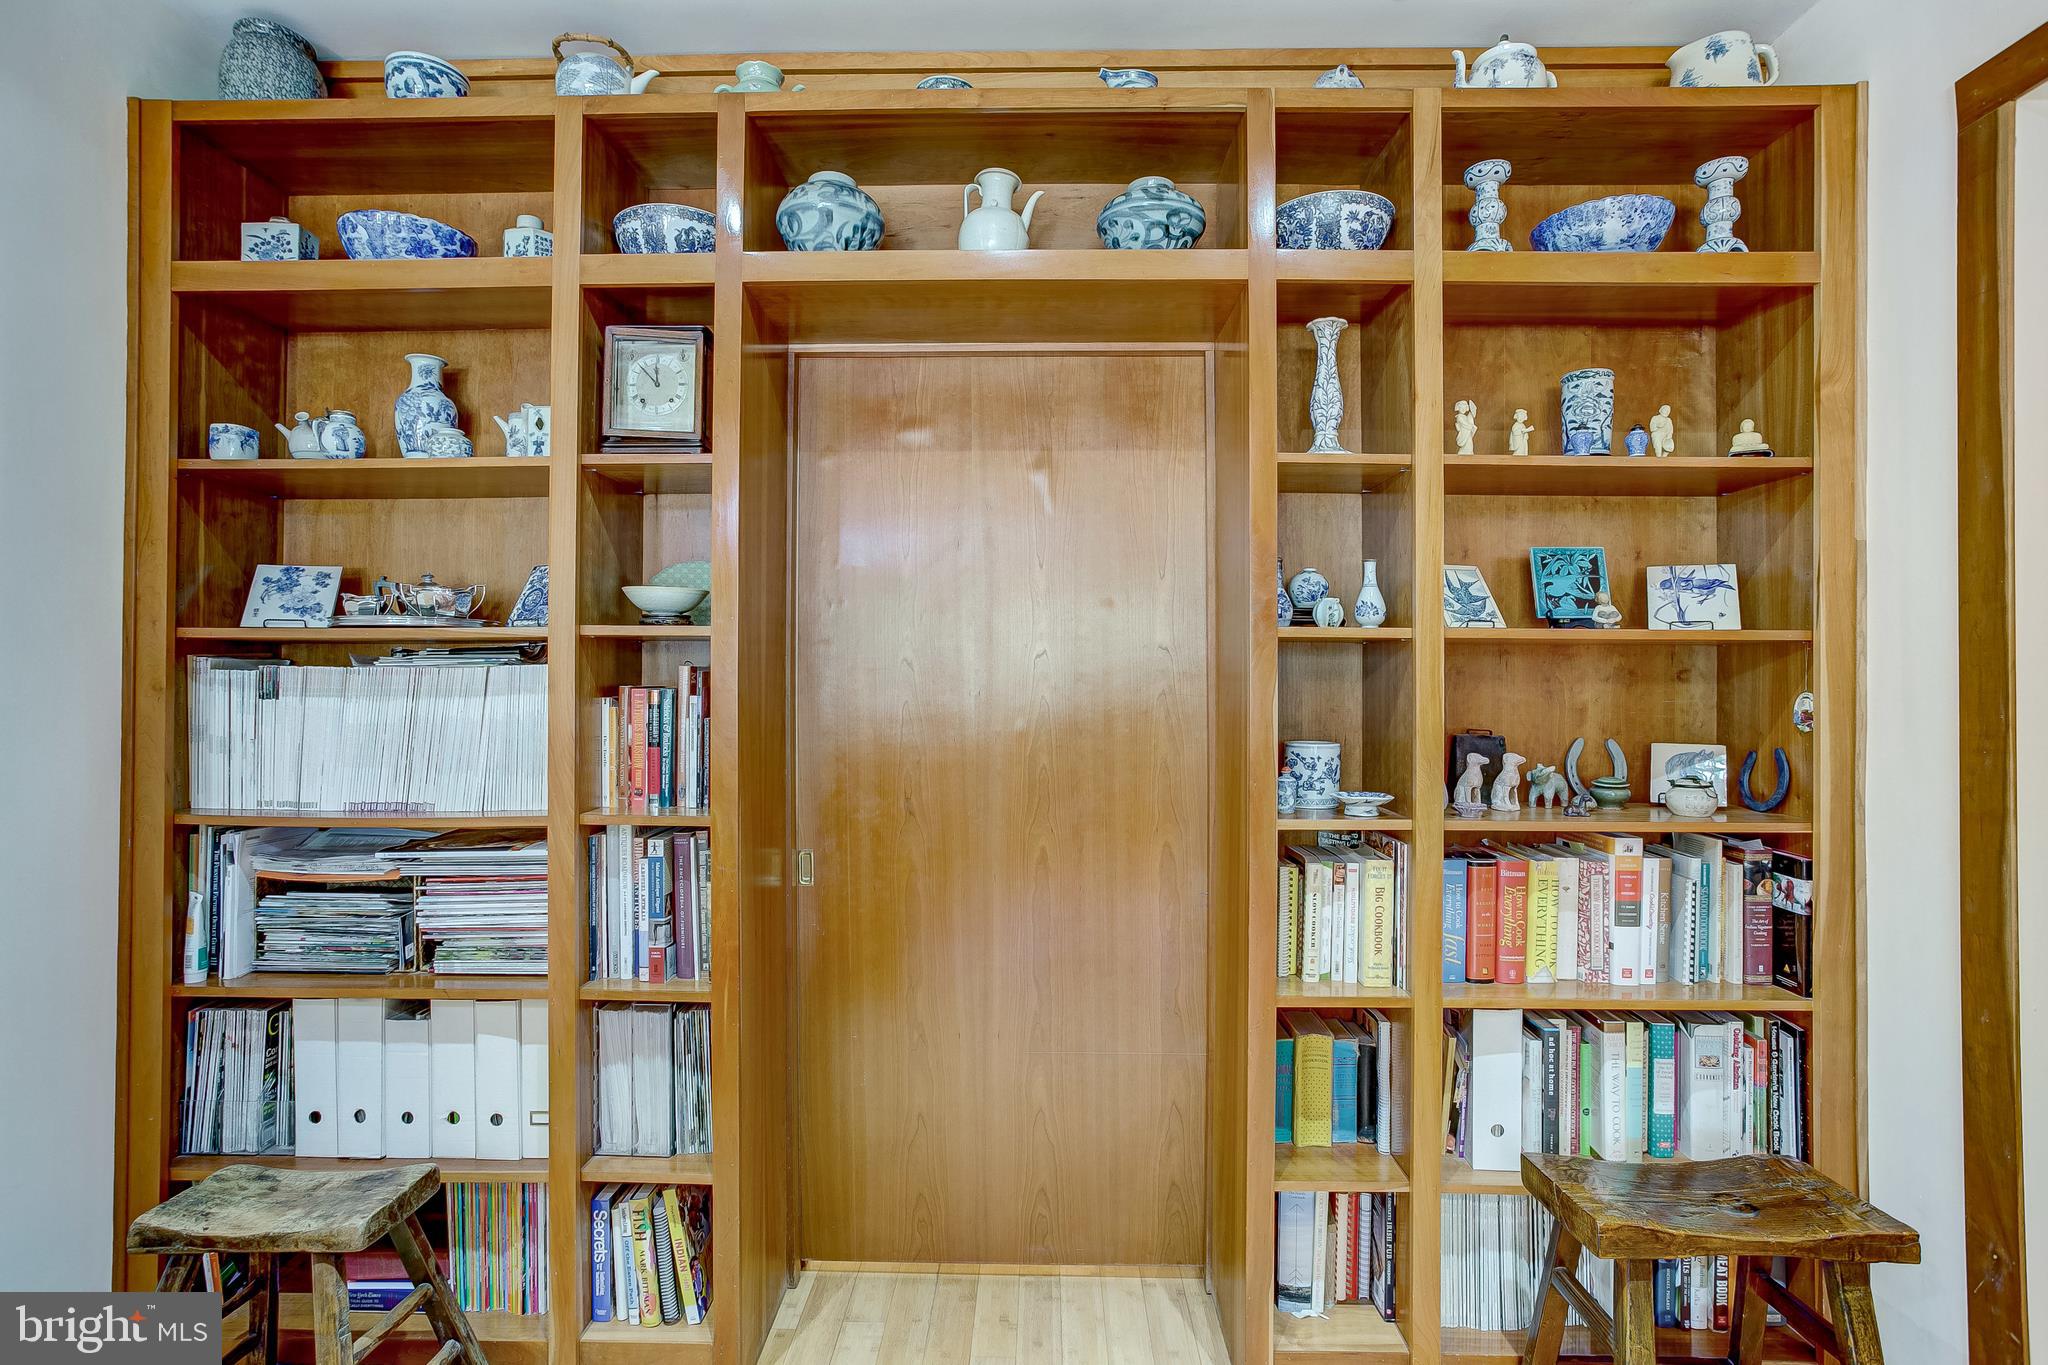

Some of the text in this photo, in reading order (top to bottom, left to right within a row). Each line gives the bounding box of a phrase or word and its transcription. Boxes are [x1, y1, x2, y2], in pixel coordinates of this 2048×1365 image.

[634, 732, 644, 768] ROADSHOW
[620, 828, 628, 856] ANTIQUES
[212, 861, 220, 890] FURNITURE
[1500, 869, 1526, 877] Bittman
[1375, 887, 1385, 903] BIG
[1443, 884, 1456, 929] Everything
[1455, 883, 1464, 900] How
[1700, 886, 1708, 916] SEAFOOD
[680, 910, 685, 919] OF
[1455, 909, 1464, 929] Cook
[1500, 886, 1517, 948] Everything
[1515, 886, 1526, 947] How to Cook
[1535, 878, 1549, 968] EVERYTHING
[1549, 878, 1560, 969] HOW TO COOK
[1659, 892, 1668, 945] Kitchen Sense
[1374, 906, 1385, 956] COOKBOOK
[1700, 916, 1708, 950] COOKBOOK
[1443, 933, 1465, 965] fast
[1731, 1028, 1740, 1057] Cooking
[1548, 1037, 1556, 1096] ad hoc at home
[1611, 1052, 1621, 1070] THE
[1611, 1074, 1621, 1095] WAY
[1612, 1099, 1621, 1113] TO
[1612, 1116, 1621, 1145] COOK
[594, 1209, 608, 1263] Secrets
[632, 1209, 647, 1241] FISH
[674, 1238, 688, 1272] INDIAN
[623, 1240, 631, 1251] Off
[627, 1288, 635, 1305] Path
[639, 1249, 651, 1314] MARK BITTMAN
[1716, 1280, 1728, 1306] BOOK
